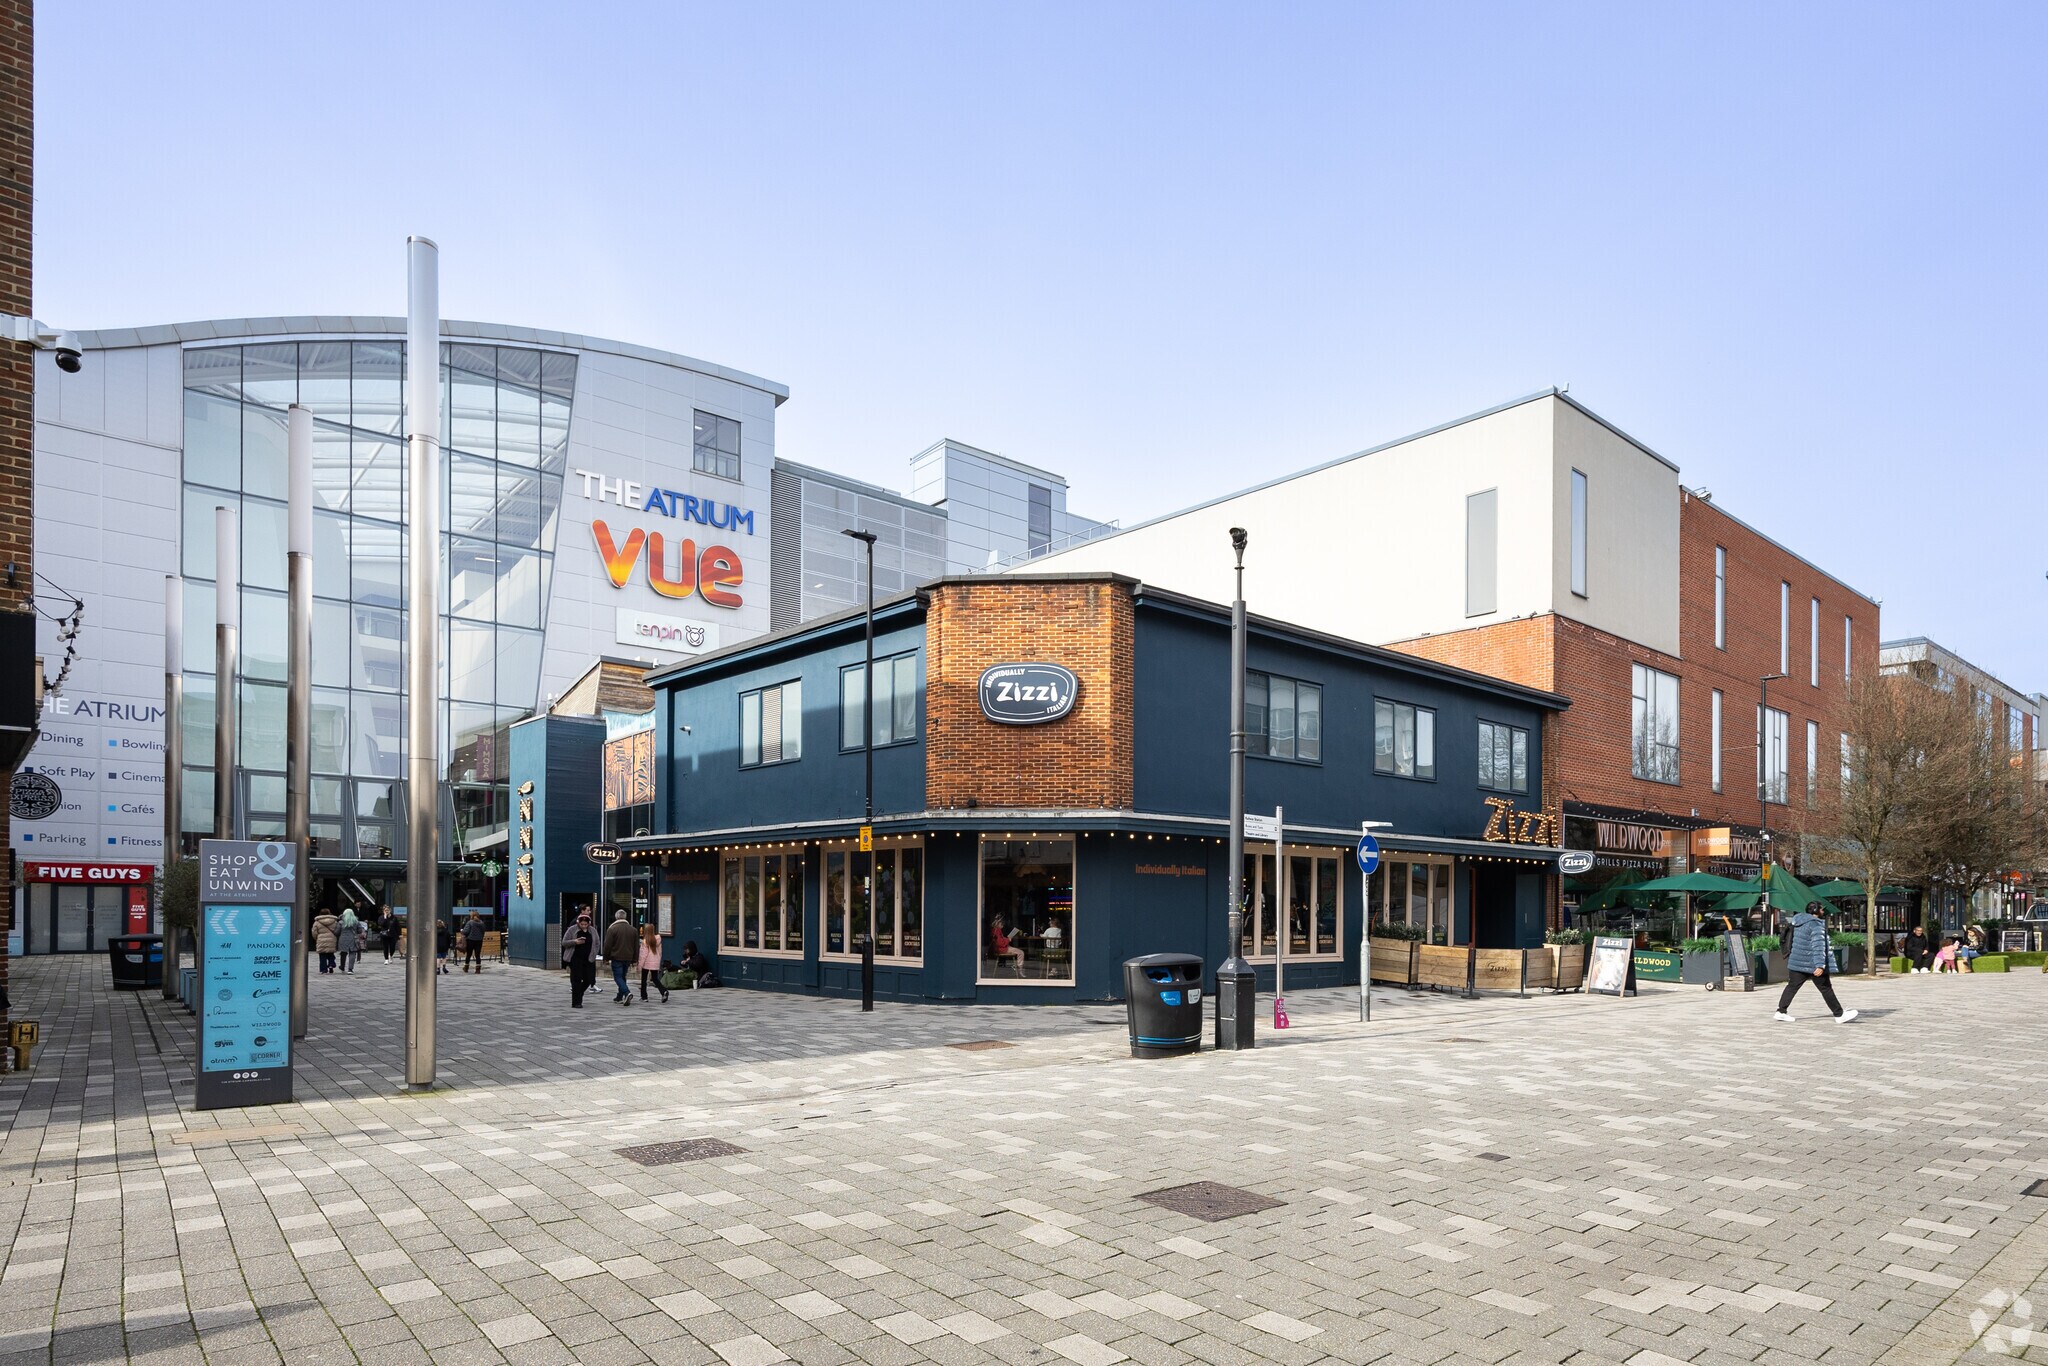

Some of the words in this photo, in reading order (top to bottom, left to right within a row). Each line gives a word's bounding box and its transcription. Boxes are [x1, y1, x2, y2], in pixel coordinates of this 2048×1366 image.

[576, 469, 641, 510] THE
[643, 487, 754, 535] ATRIUM
[634, 619, 682, 642] tenpin
[985, 668, 1025, 688] INDIVIDUALLY
[996, 681, 1059, 702] Zizzi
[43, 697, 70, 715] HE
[74, 700, 165, 723] ATRIUM
[1045, 695, 1069, 714] ITALIAN
[41, 731, 84, 747] Dining
[482, 737, 491, 778] MIMOSA
[39, 765, 66, 777] Soft
[70, 767, 96, 781] Play
[15, 788, 46, 796] PIZZA
[121, 804, 155, 814] Cafés
[1483, 796, 1558, 848] Zizzi
[39, 833, 86, 846] Parking
[121, 836, 162, 847] Fitness
[1597, 822, 1664, 852] WILDWOOD
[592, 847, 616, 858] Zizzi
[209, 855, 257, 865] SHOP
[1564, 858, 1587, 867] Zizzi
[1596, 858, 1620, 867] GRILLS
[1622, 859, 1641, 868] PIZZA
[1643, 861, 1663, 870] PASTA
[38, 866, 83, 878] FIVE
[88, 867, 141, 879] GUYS
[209, 868, 240, 877] EAT
[1135, 864, 1181, 877] Individually
[1181, 866, 1206, 876] Italian
[209, 881, 284, 891] UNWIND
[1634, 957, 1671, 967] ILDWOOD
[252, 970, 282, 979] GAME
[18, 1024, 35, 1042] H
